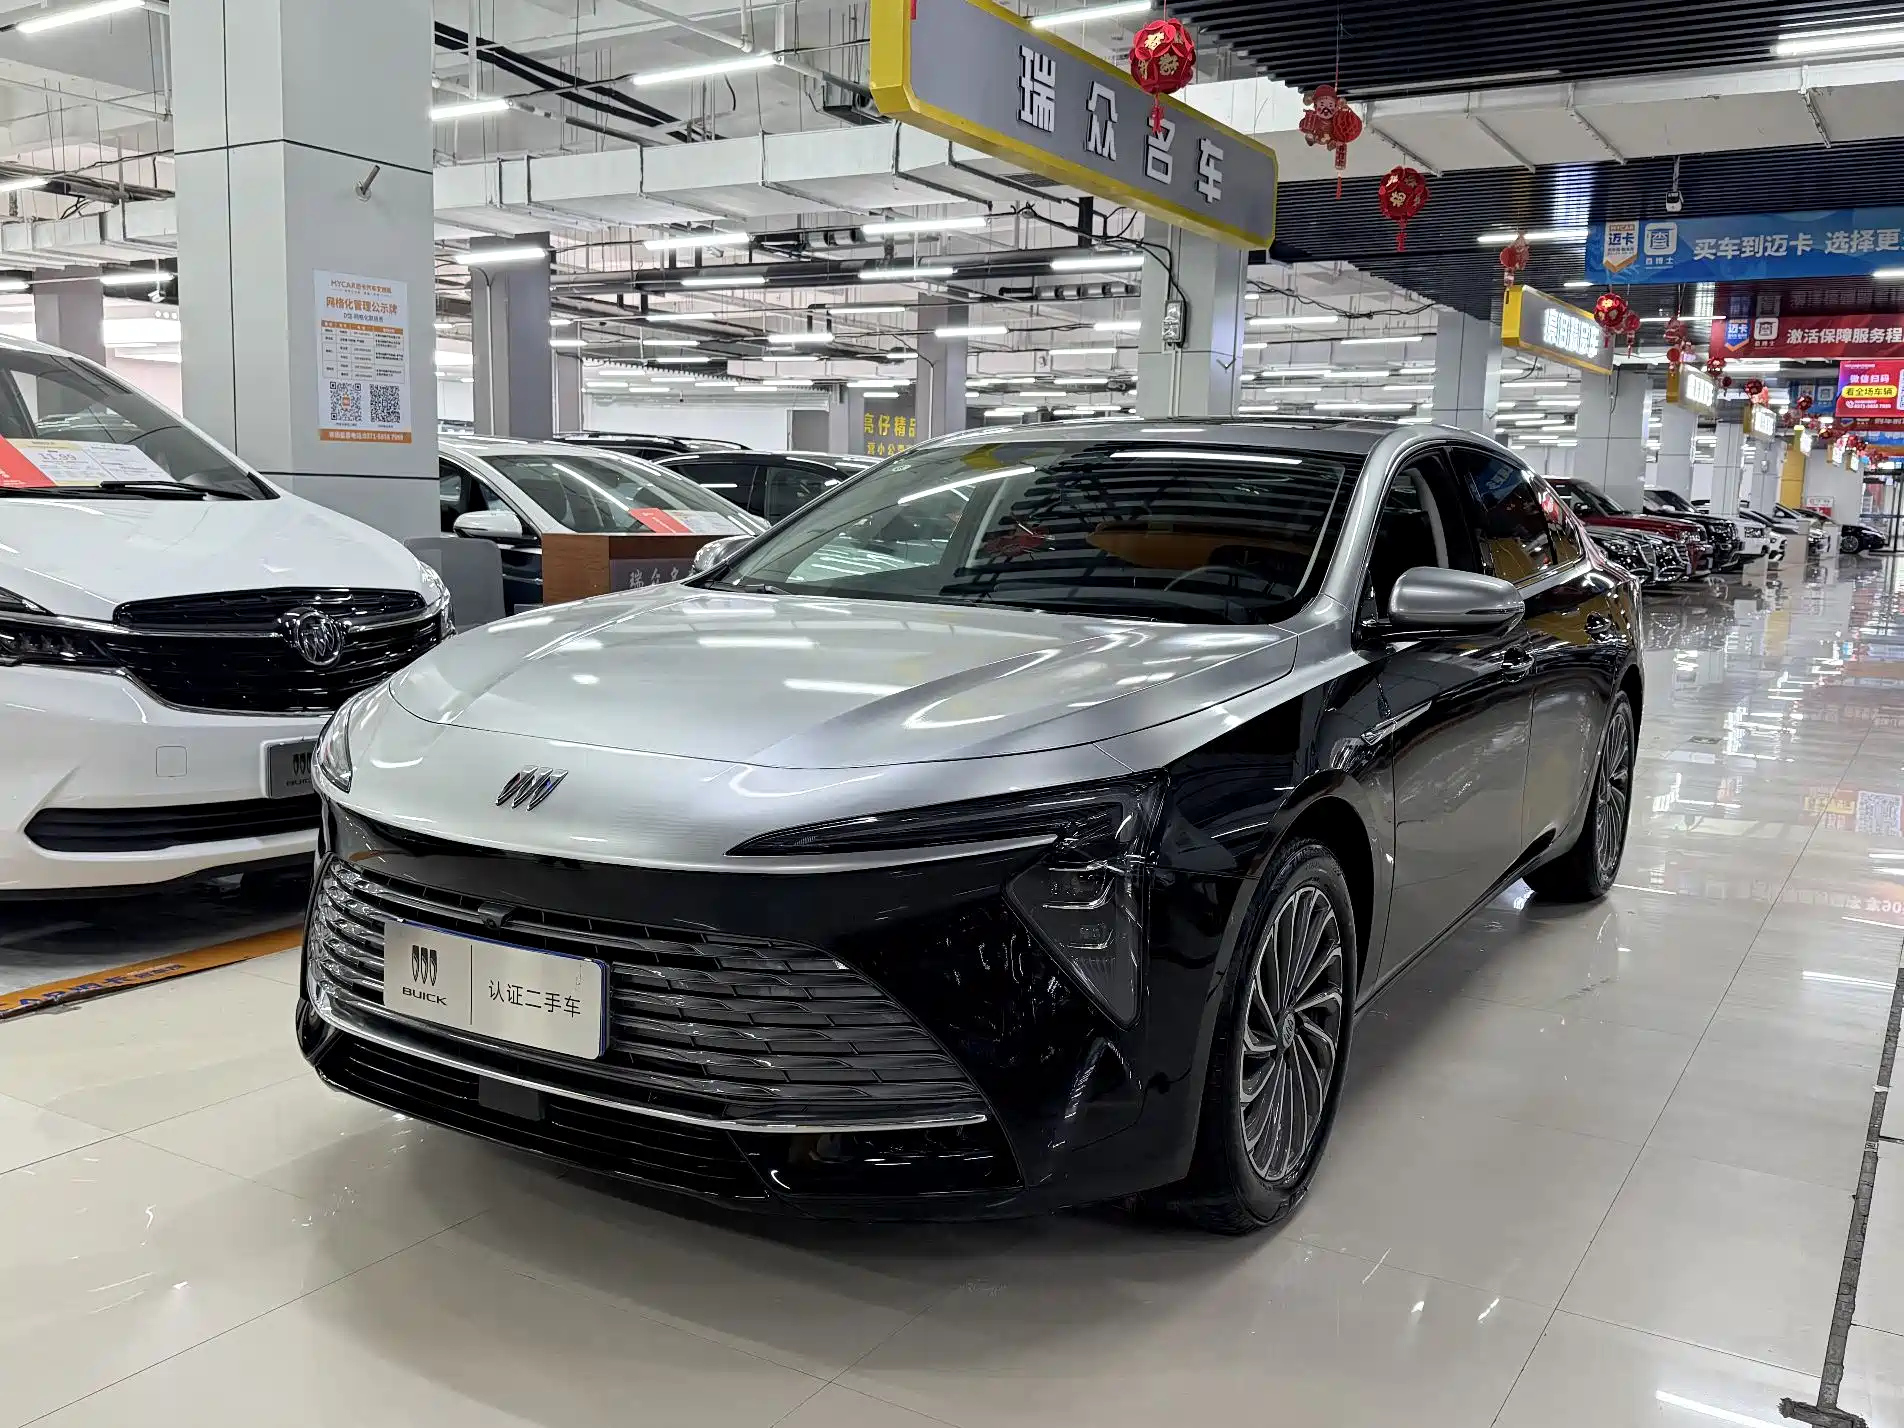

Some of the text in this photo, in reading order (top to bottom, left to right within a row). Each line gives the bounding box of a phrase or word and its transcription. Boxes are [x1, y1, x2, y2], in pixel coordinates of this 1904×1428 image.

[1016, 44, 1225, 204] 瑞众名车
[1608, 232, 1635, 246] 迈卡
[1693, 228, 1904, 261] 买车到迈卡 选择更
[1727, 323, 1748, 334] 迈卡
[1786, 327, 1904, 344] 激活保障服务程
[1846, 388, 1893, 396] 看全场车辆
[629, 564, 696, 589] 瑞众名
[402, 986, 447, 1006] BUICK
[488, 979, 581, 1018] 认证二手车
